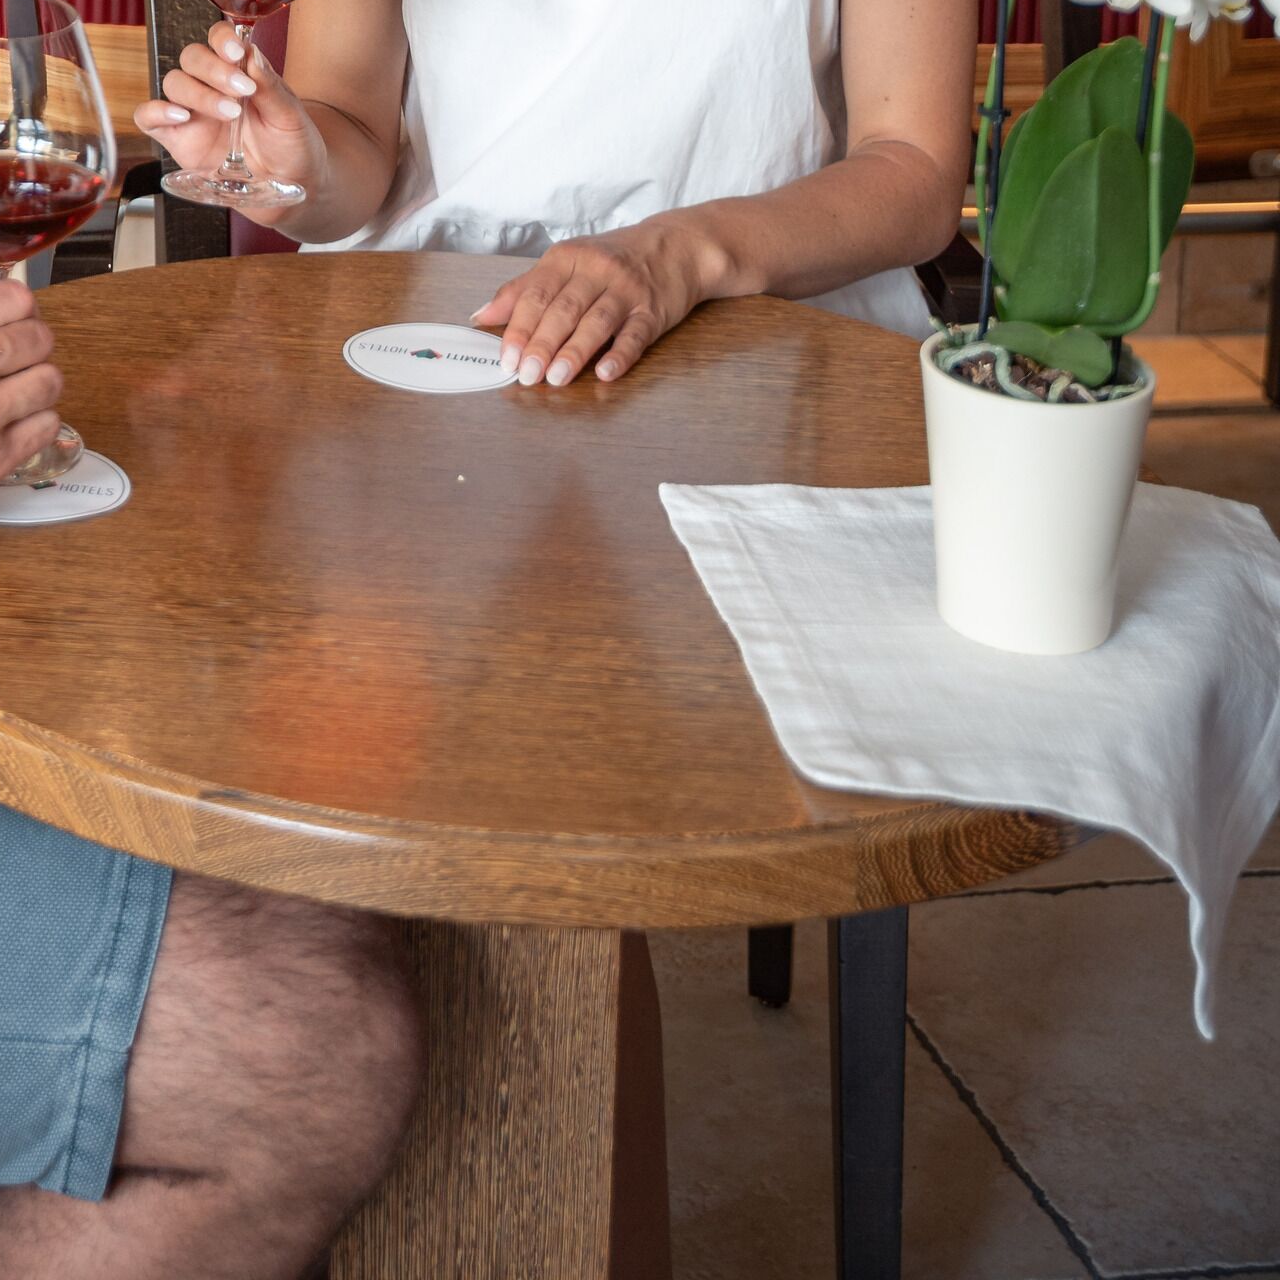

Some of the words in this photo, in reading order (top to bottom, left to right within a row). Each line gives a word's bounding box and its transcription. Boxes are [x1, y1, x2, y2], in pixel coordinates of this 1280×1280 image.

[357, 341, 409, 355] HOTELS
[445, 352, 502, 367] OLOMITI
[58, 482, 115, 498] HOTELS
